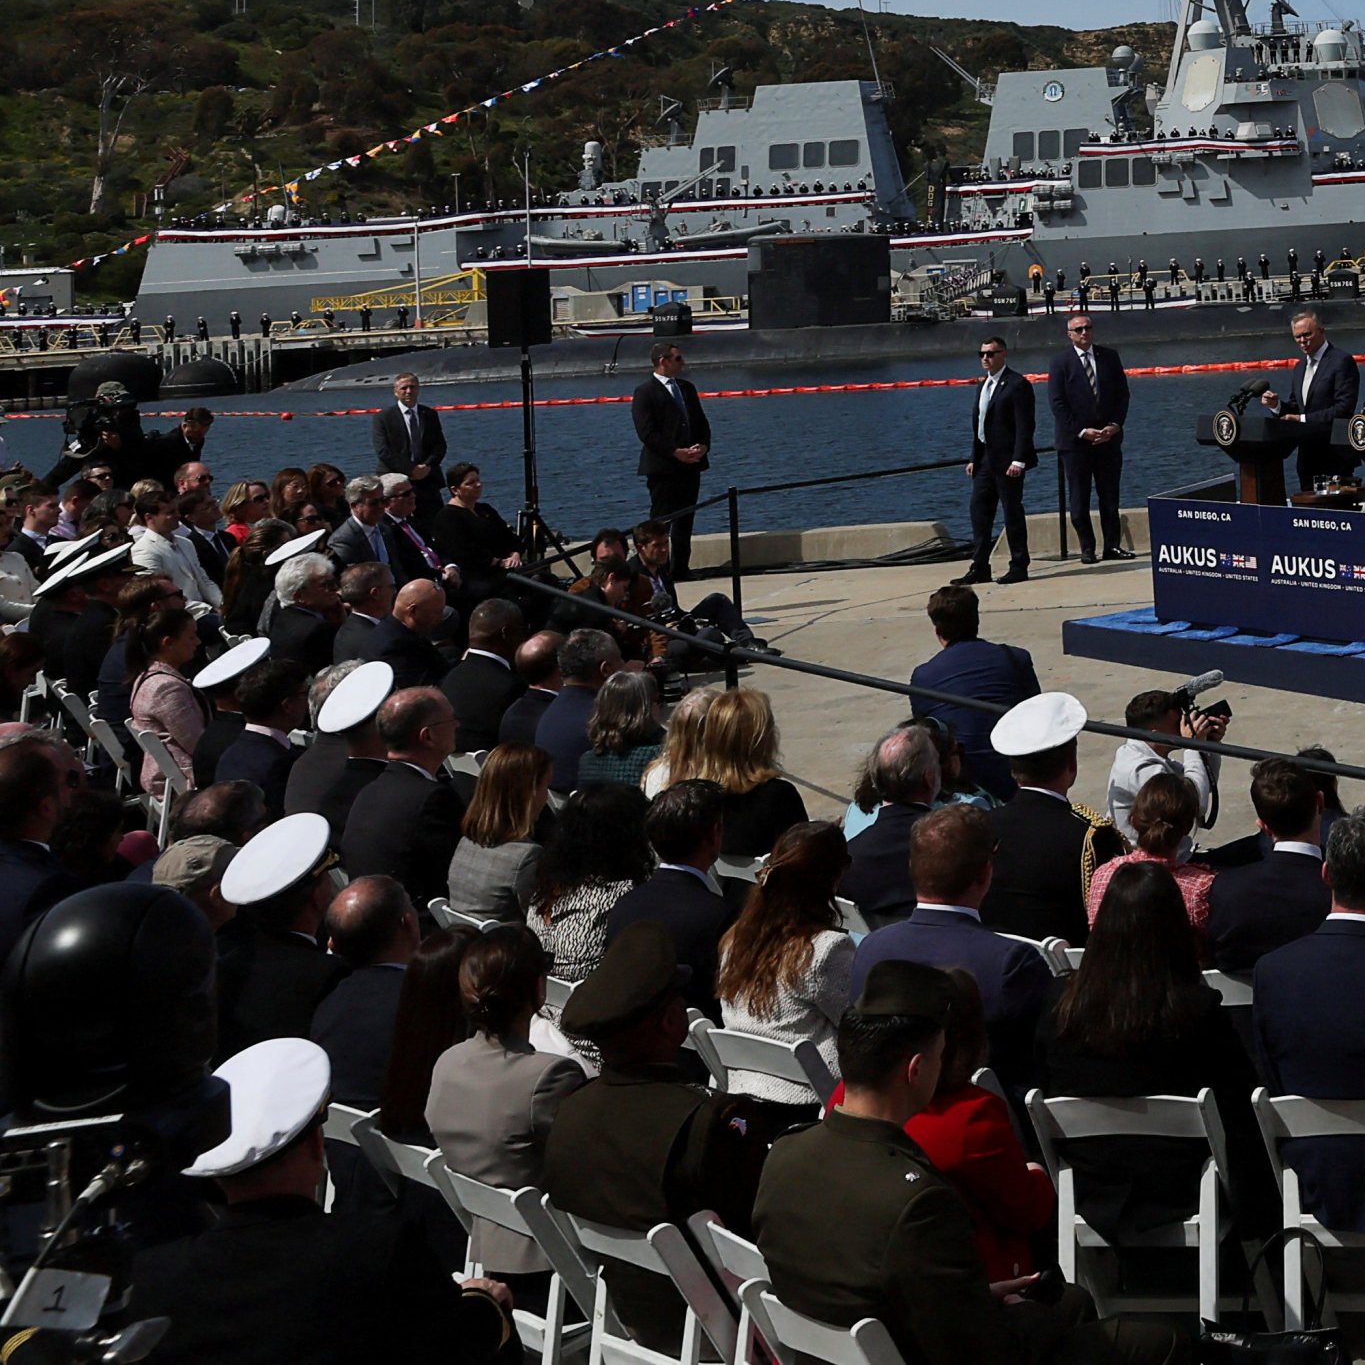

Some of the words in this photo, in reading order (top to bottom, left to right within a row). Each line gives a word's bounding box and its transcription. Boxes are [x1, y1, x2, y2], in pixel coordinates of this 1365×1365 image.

[1178, 510, 1193, 518] SAN
[1195, 511, 1220, 521] DIEGO,
[1221, 513, 1231, 521] CA
[1293, 519, 1309, 527] SAN
[1311, 520, 1339, 531] DIEGO,
[1341, 522, 1352, 531] CA
[1159, 544, 1217, 567] AUKUS
[1271, 555, 1336, 579] AUKUS
[1271, 578, 1297, 586] AUSTRALIA
[43, 1284, 66, 1311] 1
